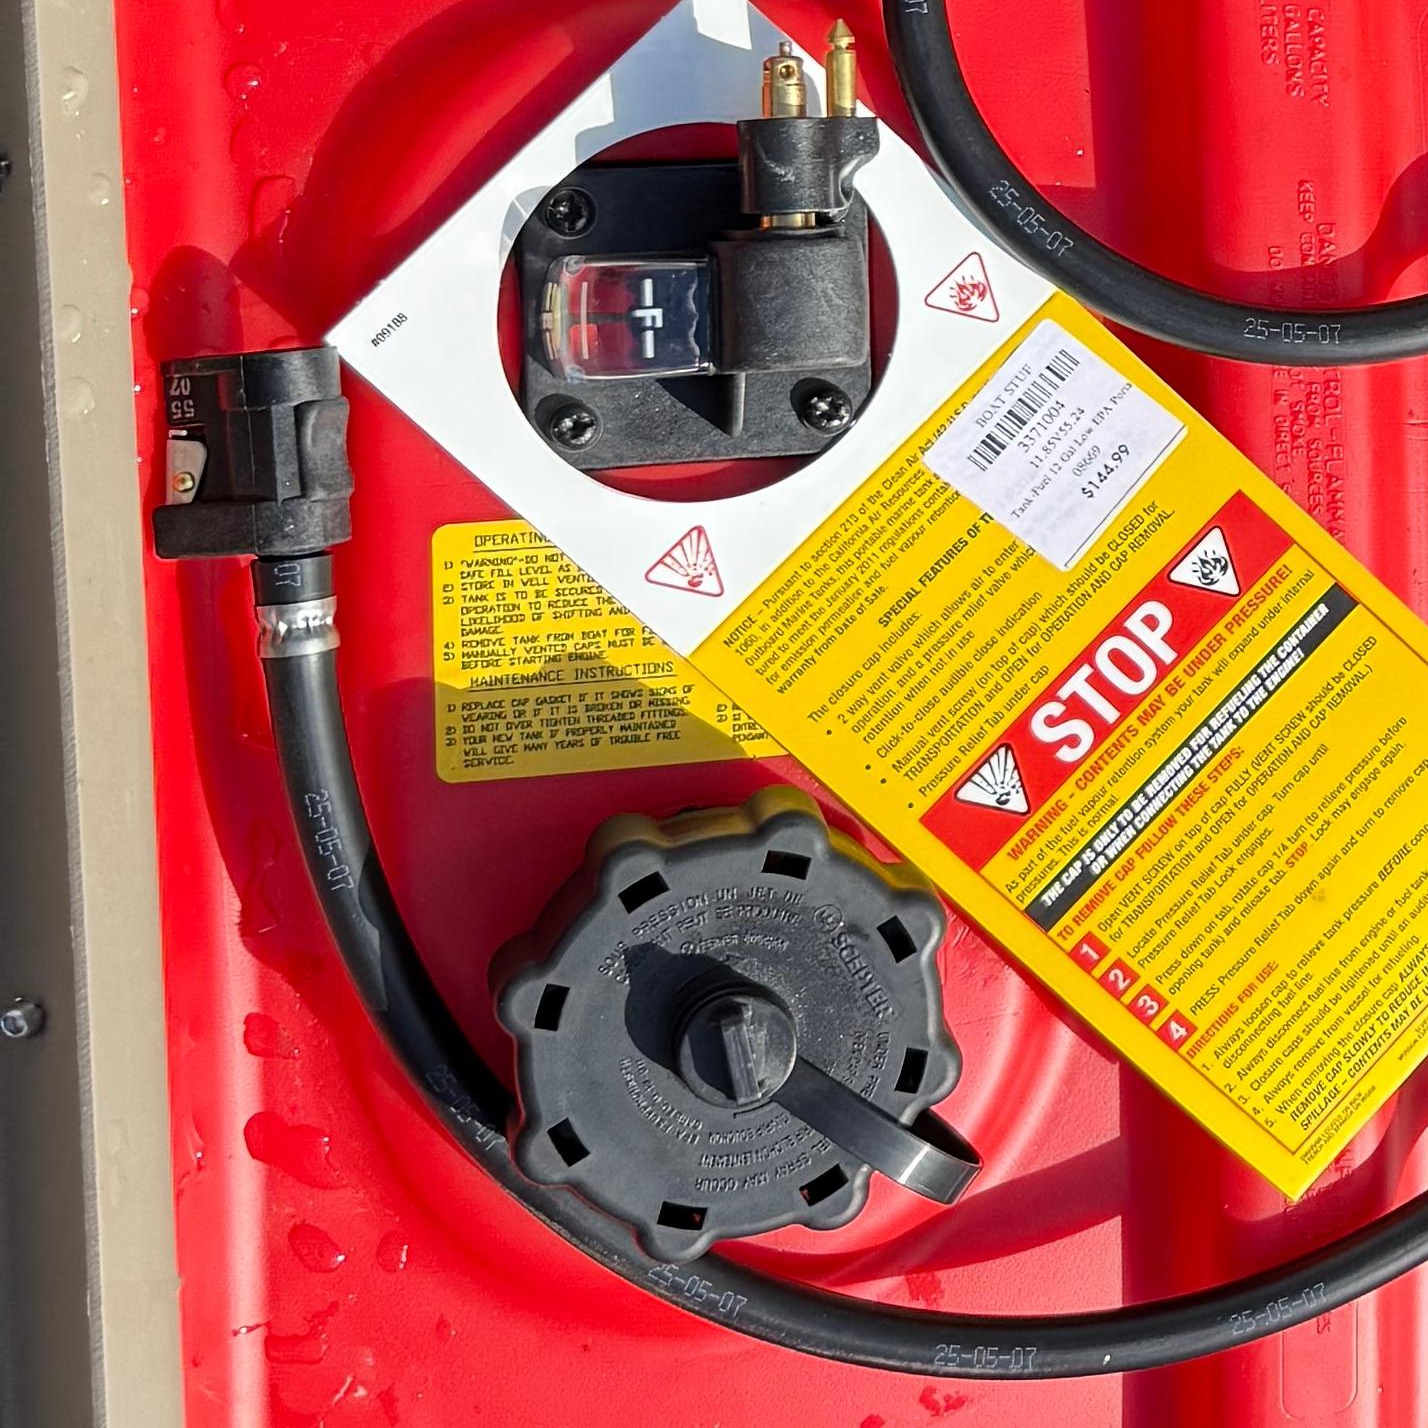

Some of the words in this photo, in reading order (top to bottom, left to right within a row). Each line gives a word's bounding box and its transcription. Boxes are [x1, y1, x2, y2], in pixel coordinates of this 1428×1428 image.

[1283, 4, 1305, 97] GALLONS
[1307, 7, 1329, 108] CAPACITY
[989, 180, 1074, 258] 25-05-07
[1243, 317, 1342, 345] 25-05-07
[975, 395, 1006, 428] BOAT
[1017, 400, 1065, 453] 3371004
[1092, 406, 1113, 425] EPA
[1081, 444, 1130, 498] $144.99
[474, 532, 551, 548] OPERATIN
[723, 614, 757, 648] NOTICE
[762, 570, 802, 609] Pursuant
[799, 562, 812, 572] to
[811, 531, 842, 562] section
[858, 502, 869, 515] of
[866, 490, 884, 505] the
[881, 466, 908, 490] Clean
[905, 453, 924, 468] Air
[878, 587, 922, 627] SPECIAL
[918, 537, 969, 588] FEATURES
[966, 522, 981, 539] OF
[470, 670, 564, 688] MAINTENANCE
[575, 661, 674, 680] INSTRUCTIONS
[807, 704, 829, 723] The
[828, 670, 863, 705] closure
[862, 652, 881, 671] cap
[878, 612, 922, 653] includes:
[876, 695, 941, 759] Click-to-close
[939, 661, 974, 696] audible
[972, 636, 998, 662] close
[995, 592, 1043, 637] indication
[1030, 601, 1178, 763] STOP
[918, 755, 961, 797] Pressure
[958, 725, 988, 756] Relief
[1003, 683, 1031, 712] under
[1030, 665, 1049, 684] cap
[1005, 879, 1019, 894] As
[1018, 859, 1038, 882] part
[1036, 847, 1048, 861] of
[1045, 834, 1062, 851] the
[1060, 814, 1080, 835] fuel
[1078, 785, 1108, 817] vapour
[1107, 747, 1146, 787] retention
[1144, 716, 1176, 749] system
[1174, 695, 1194, 718] your
[1192, 675, 1214, 696] tank
[1212, 657, 1229, 676] will
[1228, 626, 1260, 661] expand
[1257, 602, 1283, 629] under
[1280, 569, 1315, 604] internal
[1007, 799, 1068, 861] WARNING
[1075, 724, 1139, 791] CONTENTS
[1136, 694, 1166, 727] MAY
[1164, 675, 1186, 697] BE
[1183, 633, 1227, 678] UNDER
[1224, 564, 1293, 635] PRESSURE!
[1040, 881, 1065, 906] THE
[1061, 860, 1082, 886] CAP
[1081, 848, 1096, 865] IS
[1093, 821, 1120, 852] ONLY
[1116, 808, 1134, 826] TO
[1130, 793, 1149, 813] BE
[1144, 747, 1192, 798] REMOVED
[1189, 726, 1213, 751] FOR
[1208, 674, 1262, 730] REFUELING
[1257, 654, 1280, 678] THE
[1276, 603, 1329, 659] CONTAINER
[1090, 855, 1109, 875] OR
[1104, 824, 1137, 859] WHEN
[1133, 765, 1194, 830] CONNECTING
[1189, 744, 1213, 769] THE
[1208, 718, 1237, 749] TANK
[1232, 705, 1249, 723] TO
[1245, 686, 1268, 710] THE
[1264, 647, 1305, 691] ENGINE!
[304, 789, 356, 892] 25-05-07
[1057, 924, 1074, 941] TO
[1072, 879, 1117, 926] REMOVE
[1114, 857, 1135, 882] CAP
[1135, 814, 1178, 860] FOLLOW
[1174, 781, 1210, 816] THESE
[1207, 746, 1245, 783] STEPS:
[1080, 943, 1099, 960] 1
[1109, 969, 1131, 990] 2
[1138, 995, 1159, 1015] 3
[1170, 1020, 1187, 1040] 4
[1186, 1002, 1239, 1059] DIRECTIONS
[1237, 982, 1258, 1003] FOR
[1255, 961, 1279, 984] USE:
[648, 1263, 748, 1318] 25-05-07
[1229, 1281, 1327, 1335] 25-05-07
[934, 1342, 1038, 1371] 25-05-07
